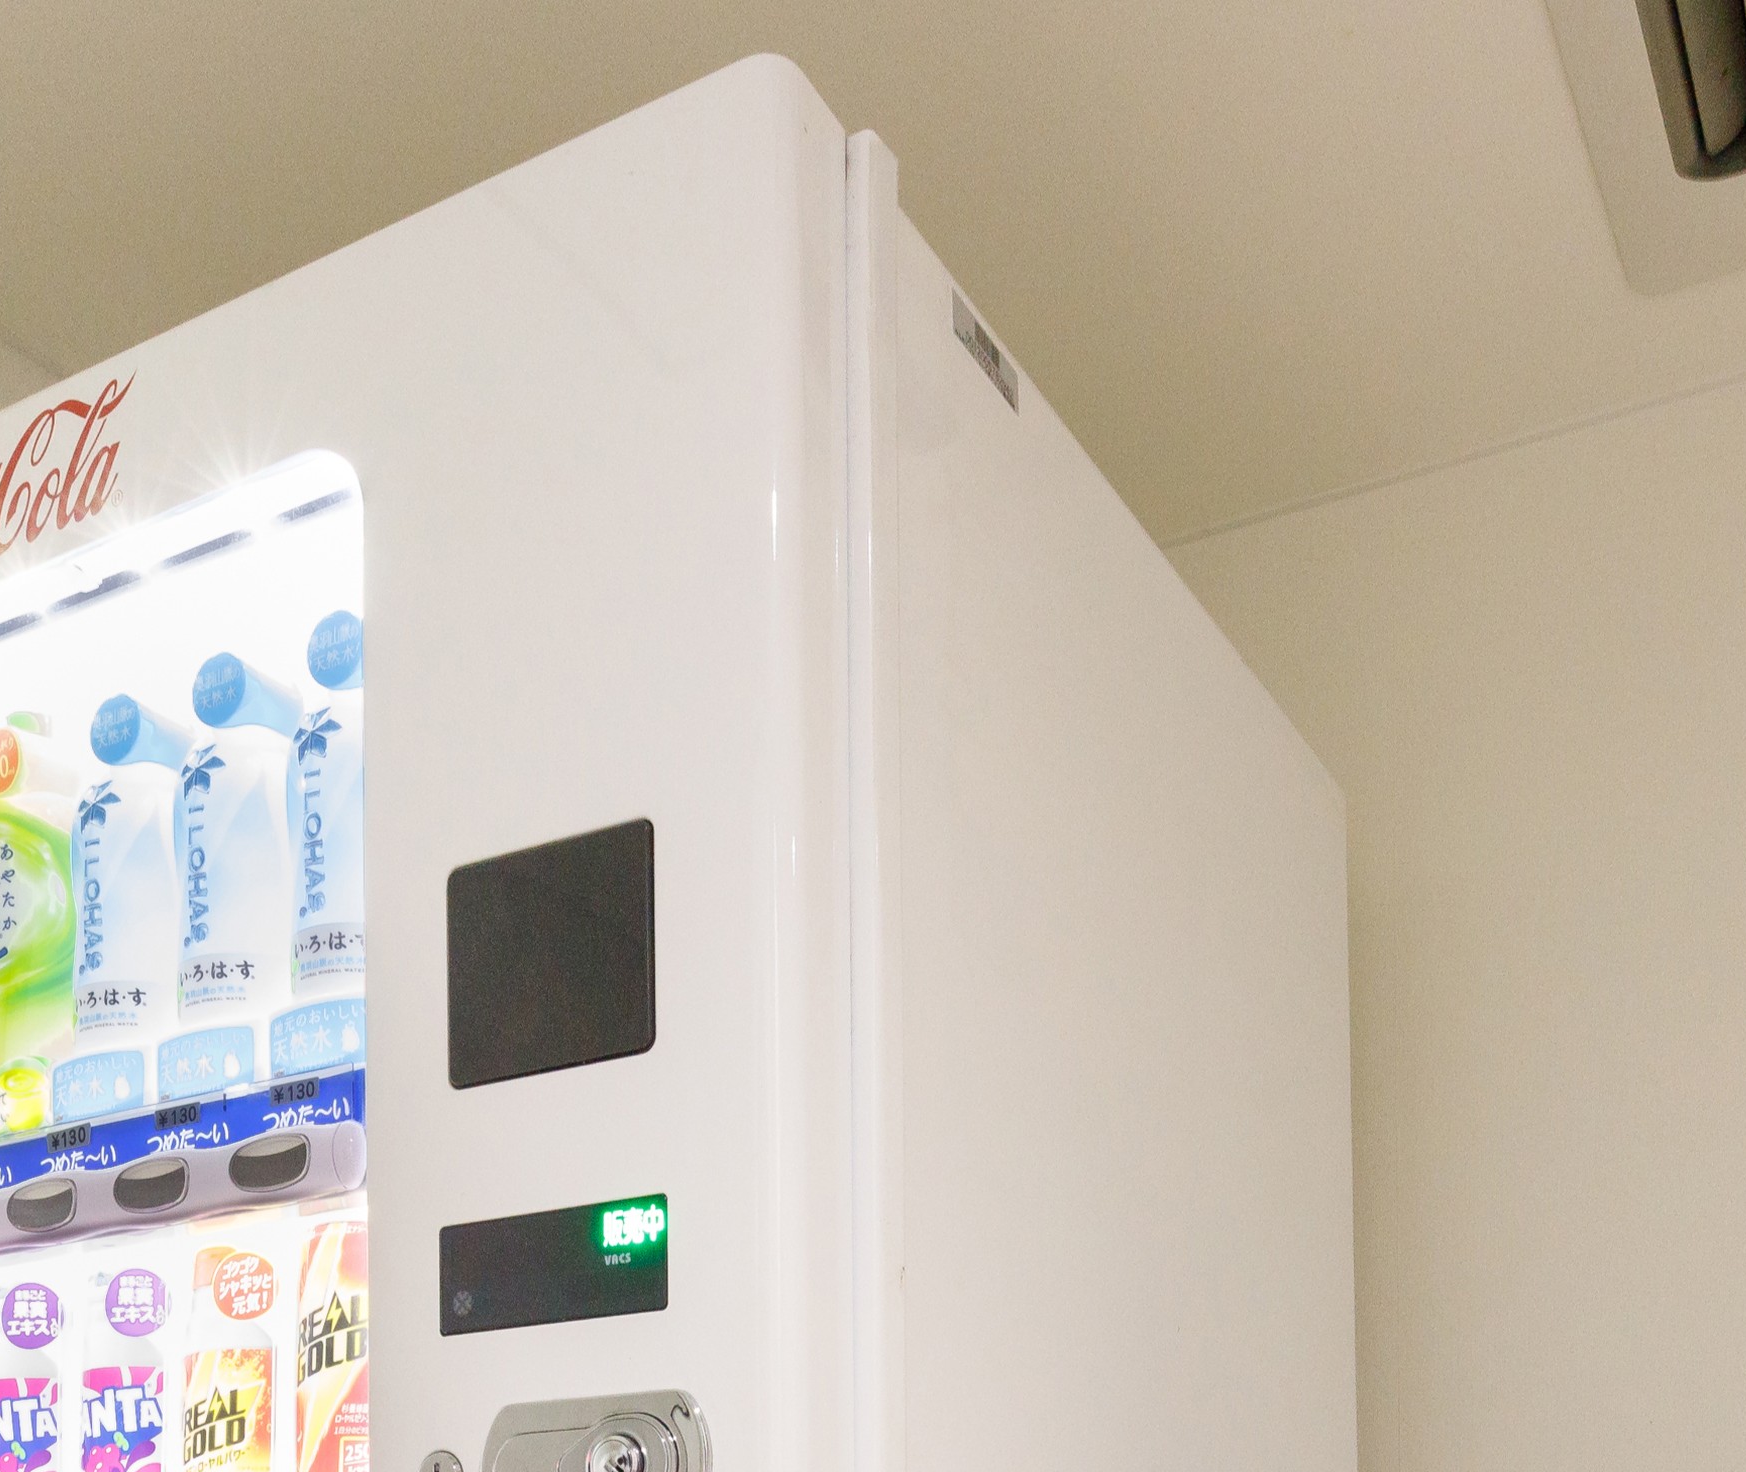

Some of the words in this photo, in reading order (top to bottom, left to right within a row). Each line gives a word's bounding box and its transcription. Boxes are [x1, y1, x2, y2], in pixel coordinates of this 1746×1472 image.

[314, 646, 359, 672] 天然水
[200, 686, 238, 711] 天然水
[0, 844, 18, 932] あやたか
[274, 1027, 331, 1065] 天然水
[161, 1054, 215, 1085] 天然水
[56, 1076, 104, 1105] 天然水
[274, 1081, 315, 1102] ¥130
[158, 1107, 198, 1126] ¥130
[52, 1129, 86, 1150] ¥130
[603, 1204, 665, 1247] 販売中
[222, 1256, 260, 1279] ゴクゴク
[605, 1252, 632, 1266] VACS
[219, 1273, 272, 1301] シャキッと
[298, 1291, 368, 1347] REAL
[297, 1327, 368, 1386] GOLD
[184, 1386, 247, 1438] REAL
[183, 1416, 247, 1465] GOLD
